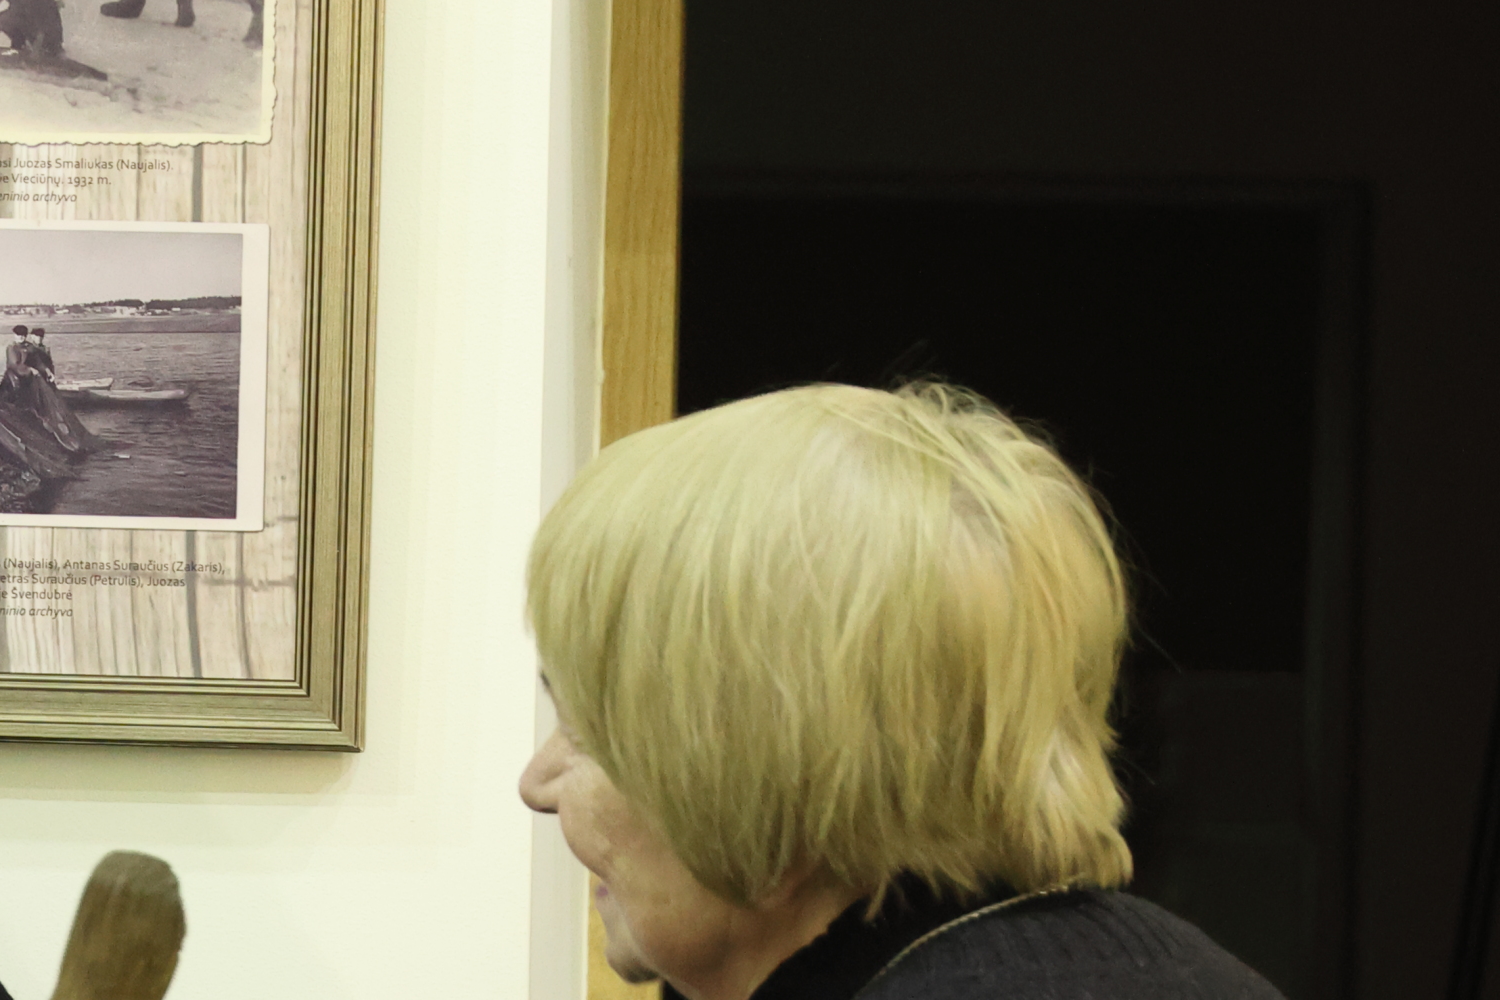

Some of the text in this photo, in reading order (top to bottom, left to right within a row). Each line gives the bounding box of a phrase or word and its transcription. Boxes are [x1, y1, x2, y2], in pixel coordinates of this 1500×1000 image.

[14, 158, 51, 168] Juozas
[55, 158, 113, 169] Smaliukas
[116, 158, 173, 172] (Naujalis).
[67, 176, 93, 186] 1932
[97, 176, 111, 185] m.
[33, 192, 77, 204] archyvo
[3, 558, 60, 571] (Naujalis),
[63, 560, 111, 570] Antanas
[90, 574, 144, 588] (Petrulis),
[147, 576, 185, 587] Juozas
[29, 604, 73, 618] archyvo
